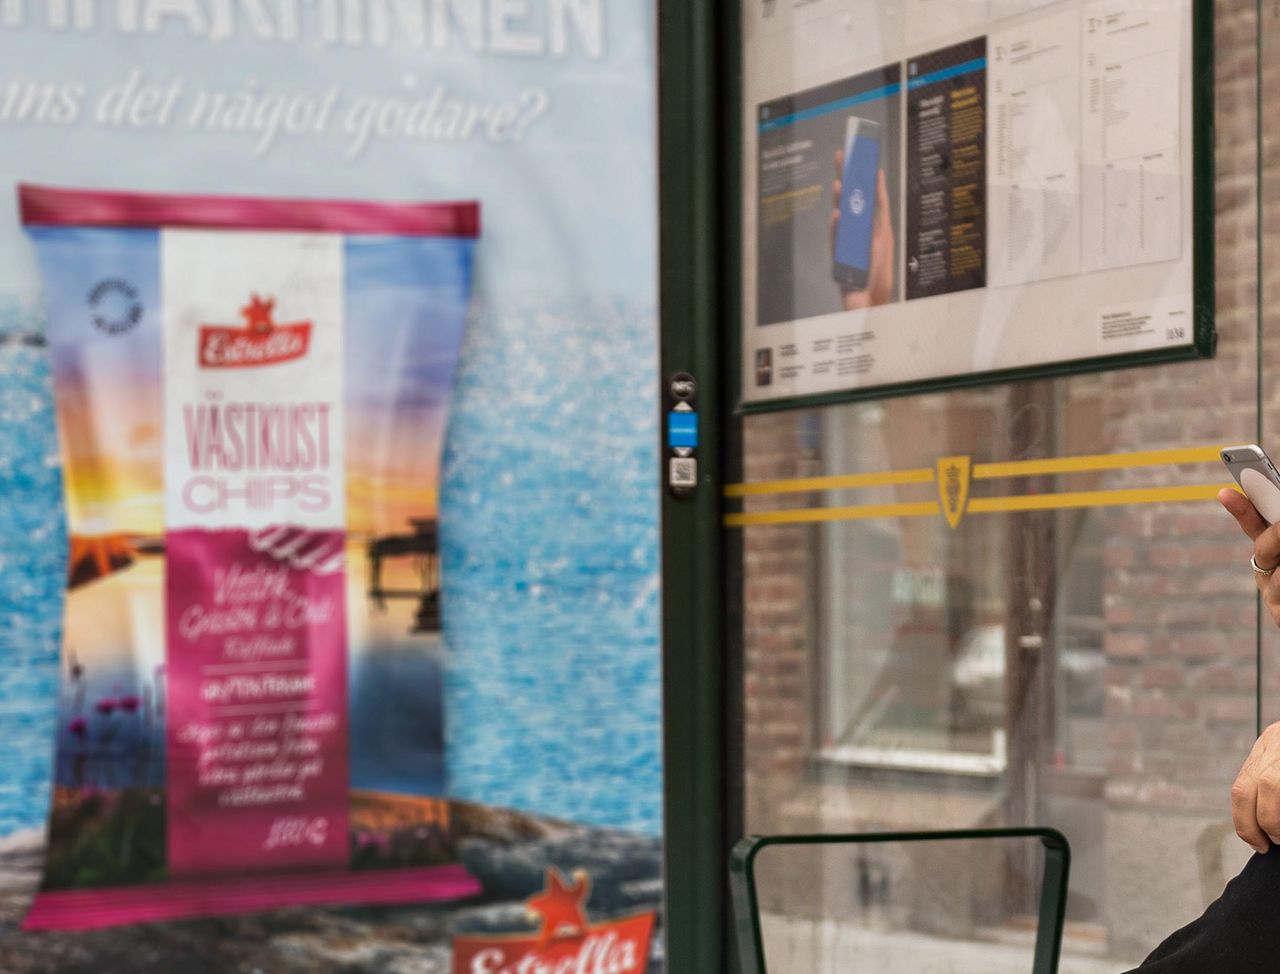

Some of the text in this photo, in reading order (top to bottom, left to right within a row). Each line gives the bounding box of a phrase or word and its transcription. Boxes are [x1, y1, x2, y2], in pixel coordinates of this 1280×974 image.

[95, 66, 183, 126] det
[186, 75, 341, 156] något
[343, 82, 548, 163] godare?
[181, 389, 332, 471] VÄSTKUST
[181, 474, 332, 516] CHIPS
